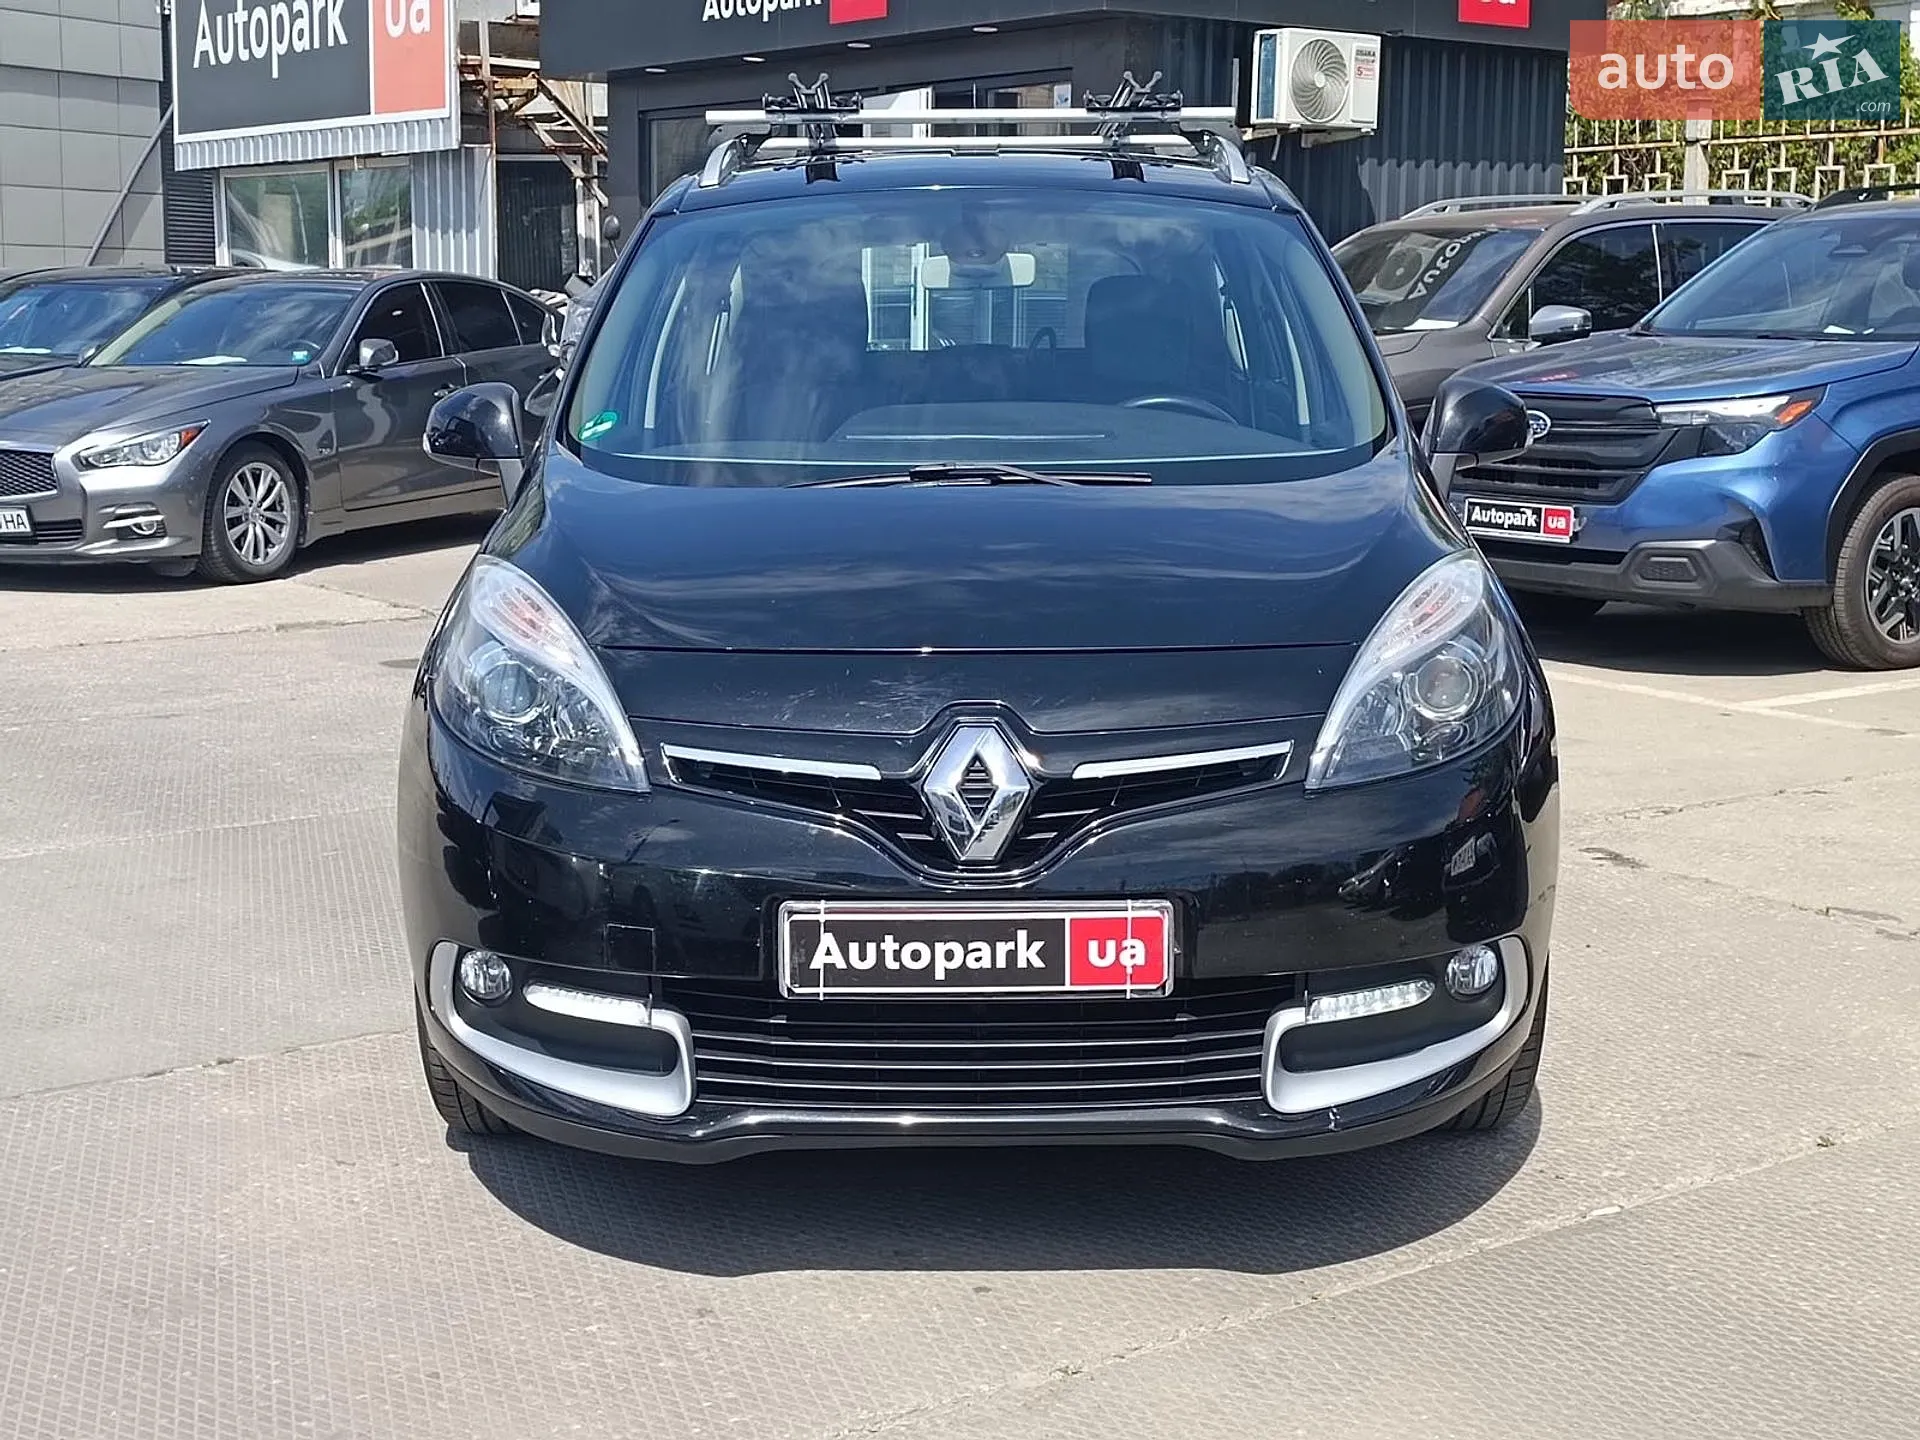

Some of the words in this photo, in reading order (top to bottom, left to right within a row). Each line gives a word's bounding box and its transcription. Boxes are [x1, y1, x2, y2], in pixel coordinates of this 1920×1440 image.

[193, 0, 348, 79] Autopark
[1471, 505, 1537, 528] Autopark
[1547, 516, 1566, 528] ua
[809, 929, 1045, 980] Autopark
[1087, 936, 1146, 968] ua
